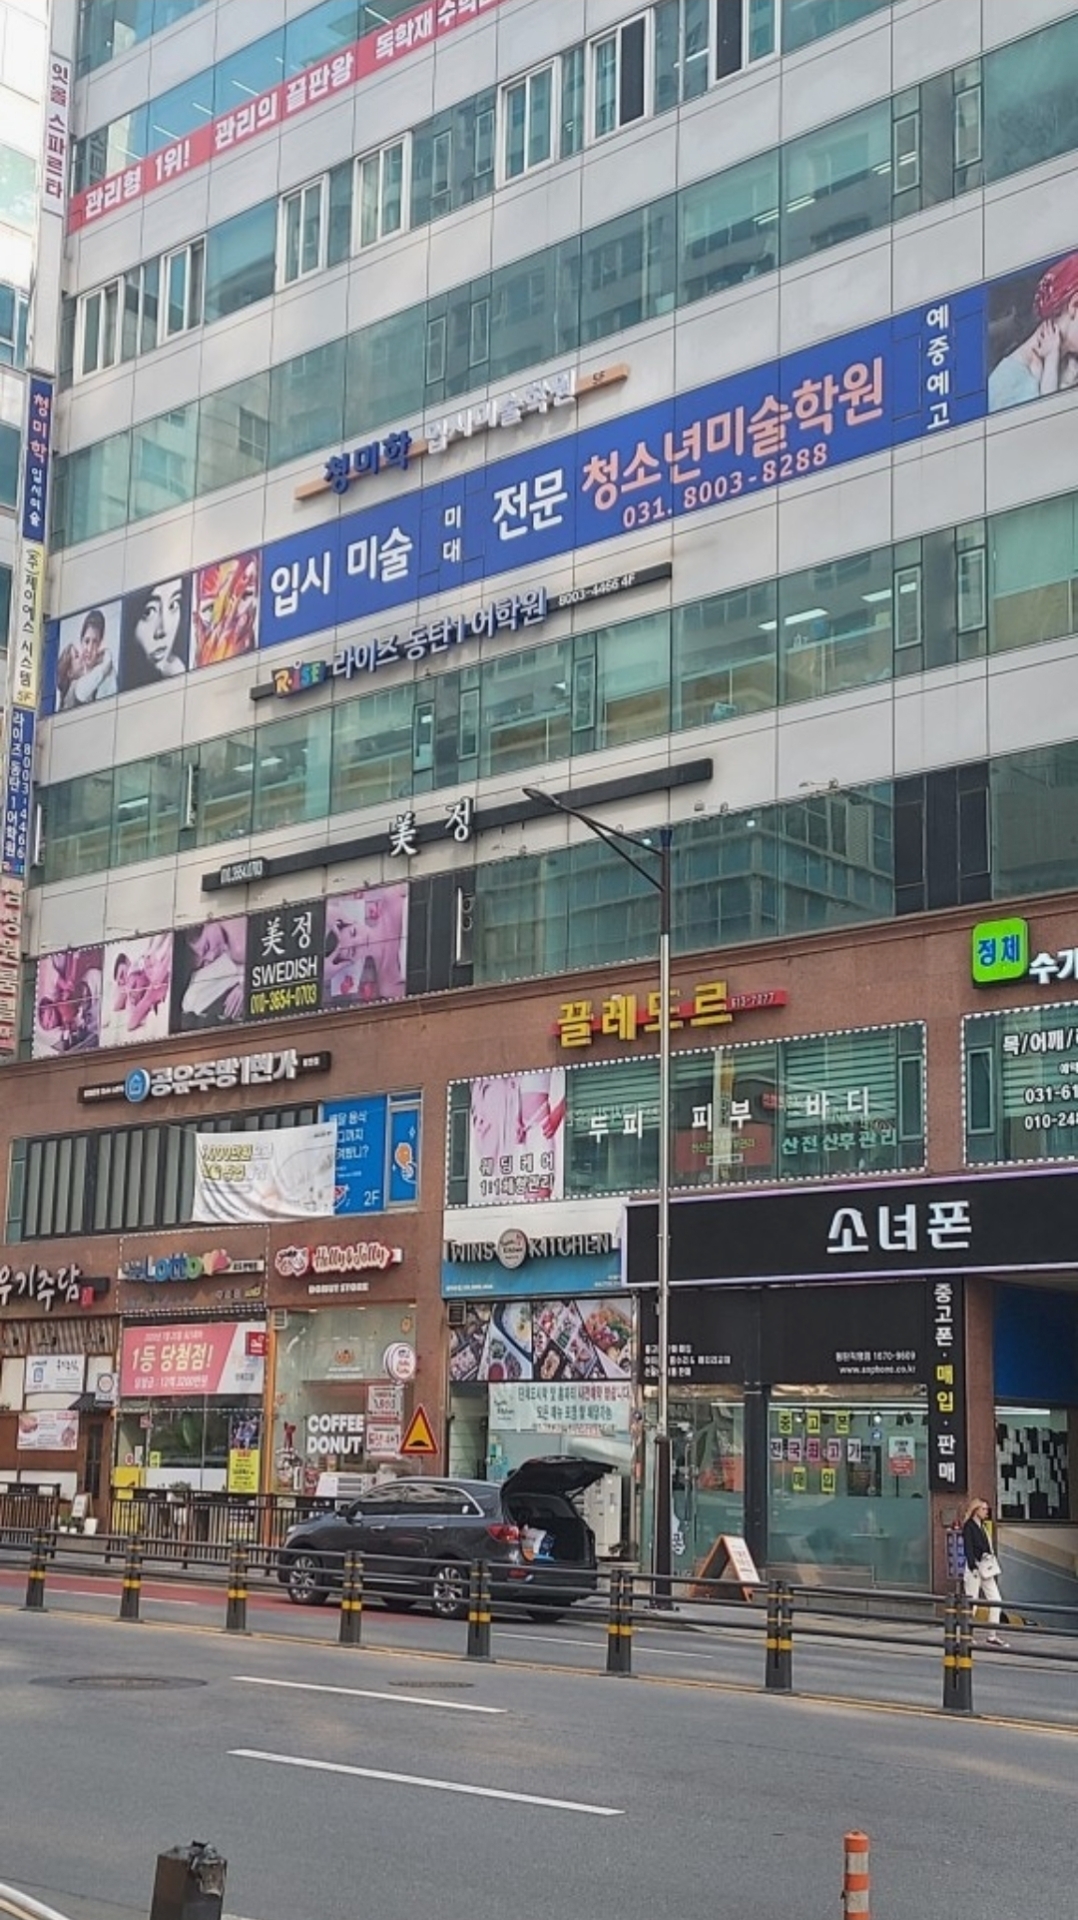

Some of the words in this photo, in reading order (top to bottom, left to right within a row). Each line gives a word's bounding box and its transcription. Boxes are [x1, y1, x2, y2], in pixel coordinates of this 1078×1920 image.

[85, 165, 141, 219] 관리형
[154, 139, 191, 182] 1위!
[214, 91, 277, 150] 관리의
[286, 52, 354, 113] 끝판왕
[376, 7, 433, 59] 독학재
[45, 114, 68, 200] 스파르타
[924, 302, 952, 431] 예중예고
[30, 393, 49, 464] 청미학
[323, 429, 412, 496] 청미학
[426, 368, 578, 454] 입시미술학원
[492, 468, 568, 541] 전문
[580, 355, 885, 512] 청소년미술학원
[683, 441, 829, 510] 8003-8288
[441, 504, 462, 564] 미대
[270, 549, 332, 618] 입시
[346, 527, 413, 583] 미술
[331, 638, 401, 681] 라이즈
[470, 585, 549, 639] 어학원
[20, 640, 33, 688] 시스템
[251, 955, 319, 988] SWEDISH
[978, 933, 1021, 968] 정체
[691, 1098, 753, 1132] 피부
[805, 1085, 870, 1121] 바디
[781, 1134, 818, 1155] 산전
[858, 1127, 898, 1147] 관리
[363, 1189, 381, 1207] 2F
[529, 1232, 612, 1259] KITCHEN
[825, 1199, 973, 1255] 소녀폰
[308, 1283, 340, 1295] DONUT
[933, 1282, 954, 1347] 중고폰
[131, 1344, 157, 1373] 1등
[160, 1341, 215, 1373] 당첨점!
[936, 1363, 955, 1412] 매입
[305, 1436, 362, 1454] DONUT
[307, 1413, 365, 1433] COFFEE
[937, 1433, 957, 1484] 판매
